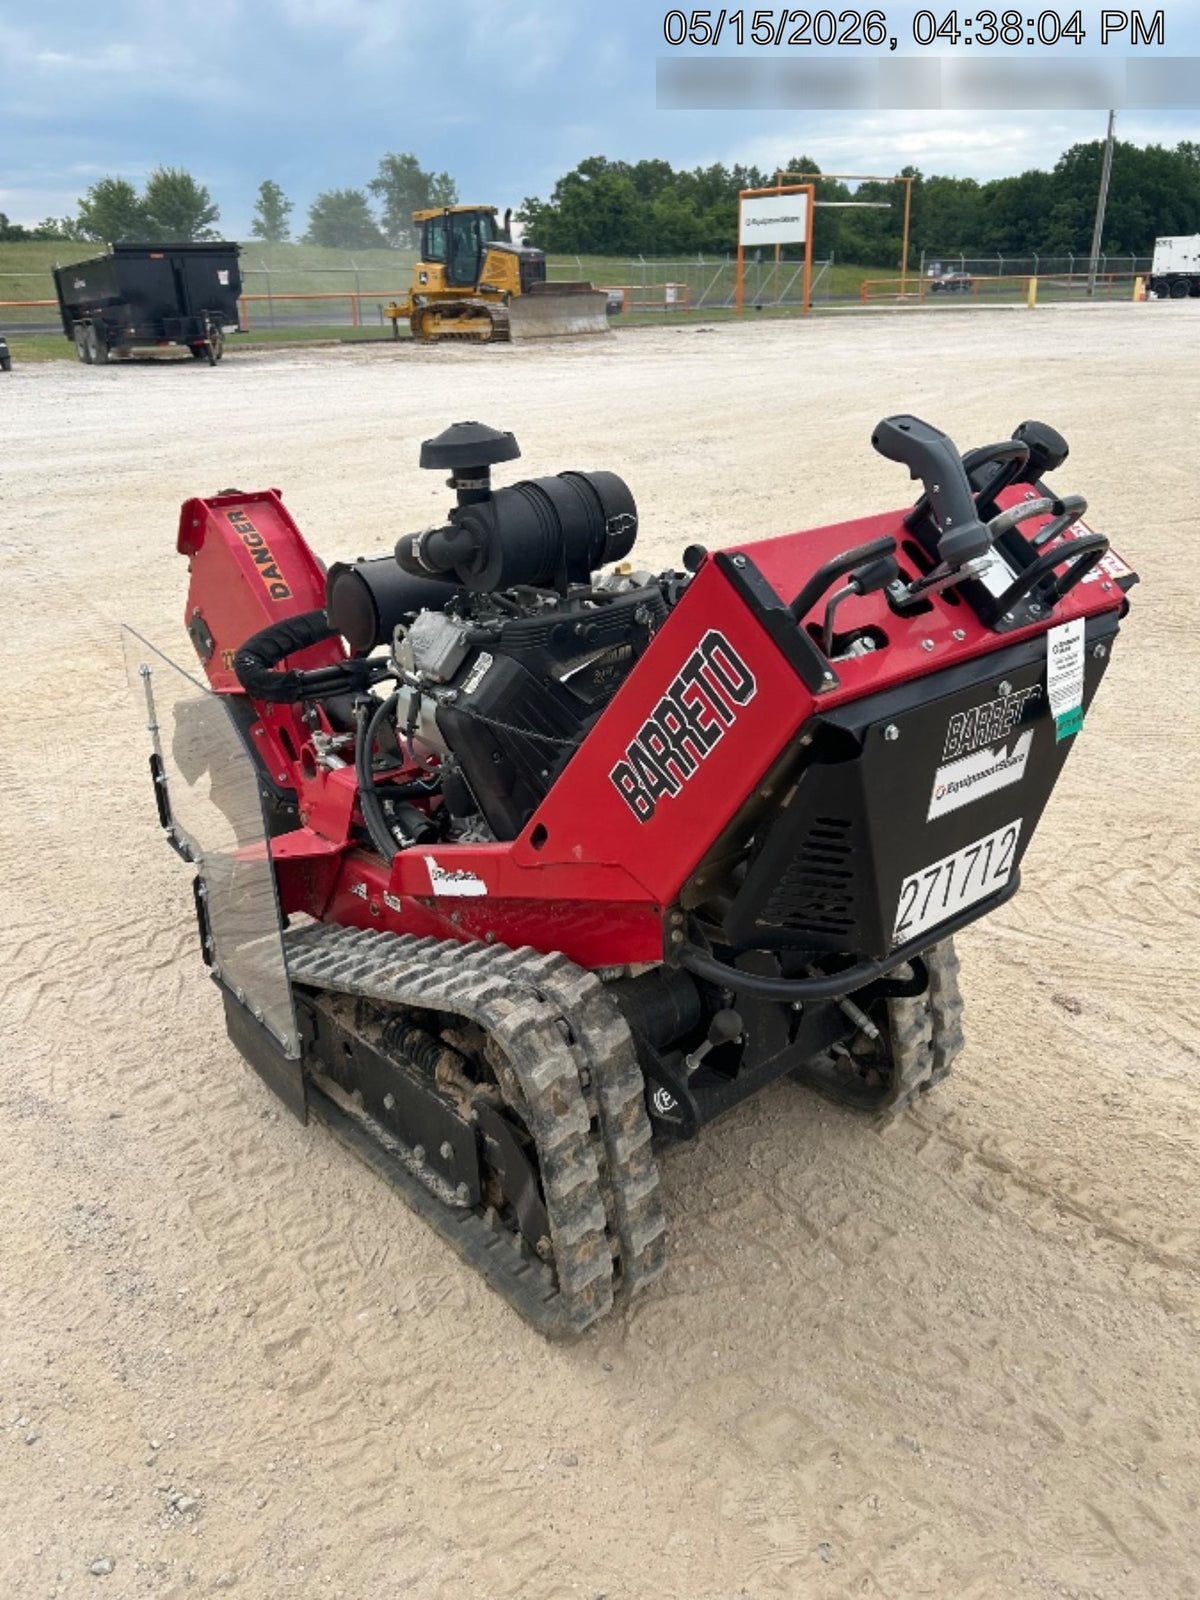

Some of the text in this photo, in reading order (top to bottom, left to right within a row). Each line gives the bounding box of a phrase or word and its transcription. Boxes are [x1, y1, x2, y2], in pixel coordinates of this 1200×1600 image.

[227, 511, 291, 599] DANGER
[608, 629, 757, 824] BARRETO
[895, 827, 1017, 934] 271712
